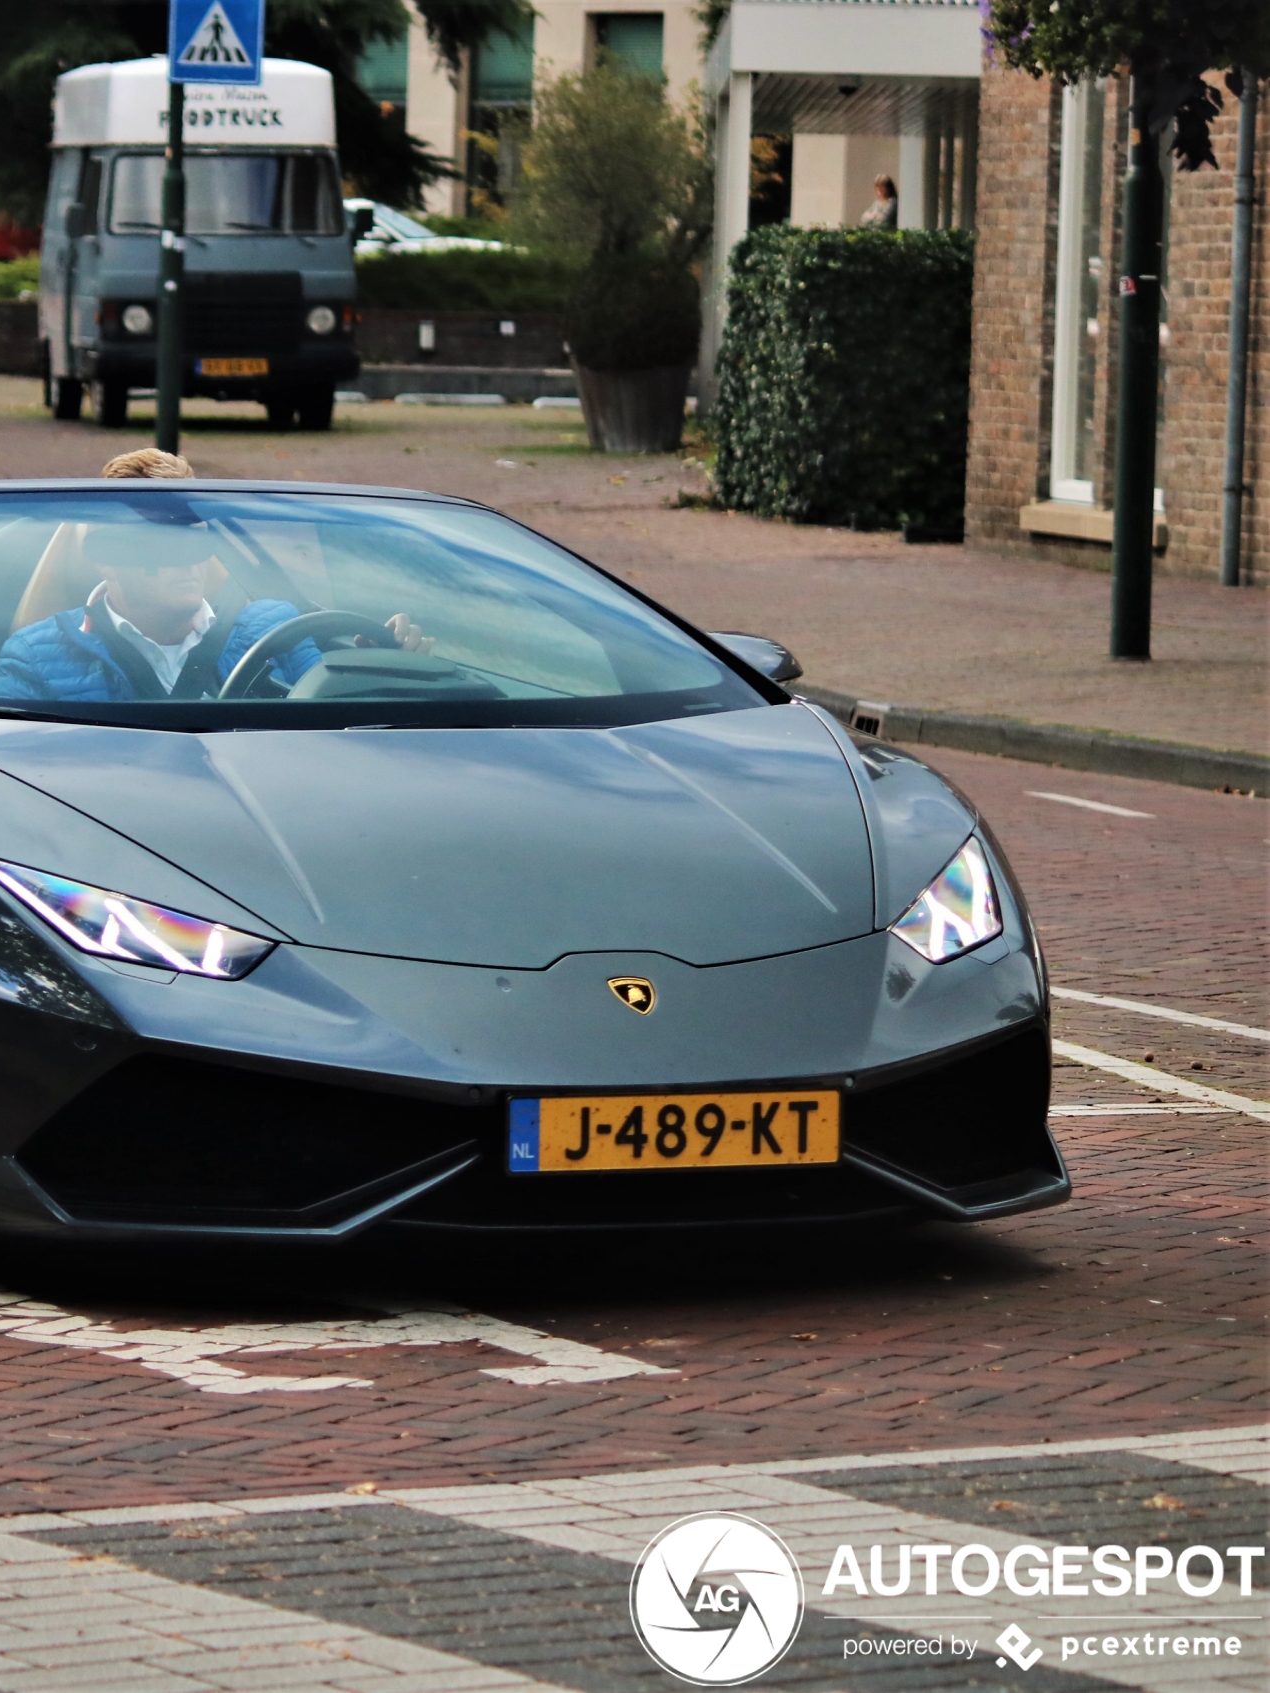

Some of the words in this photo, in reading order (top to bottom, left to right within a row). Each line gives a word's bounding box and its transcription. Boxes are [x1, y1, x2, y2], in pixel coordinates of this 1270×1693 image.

[159, 108, 284, 128] FODTRUCK
[512, 1143, 535, 1159] NL
[565, 1101, 819, 1161] J-489-KT
